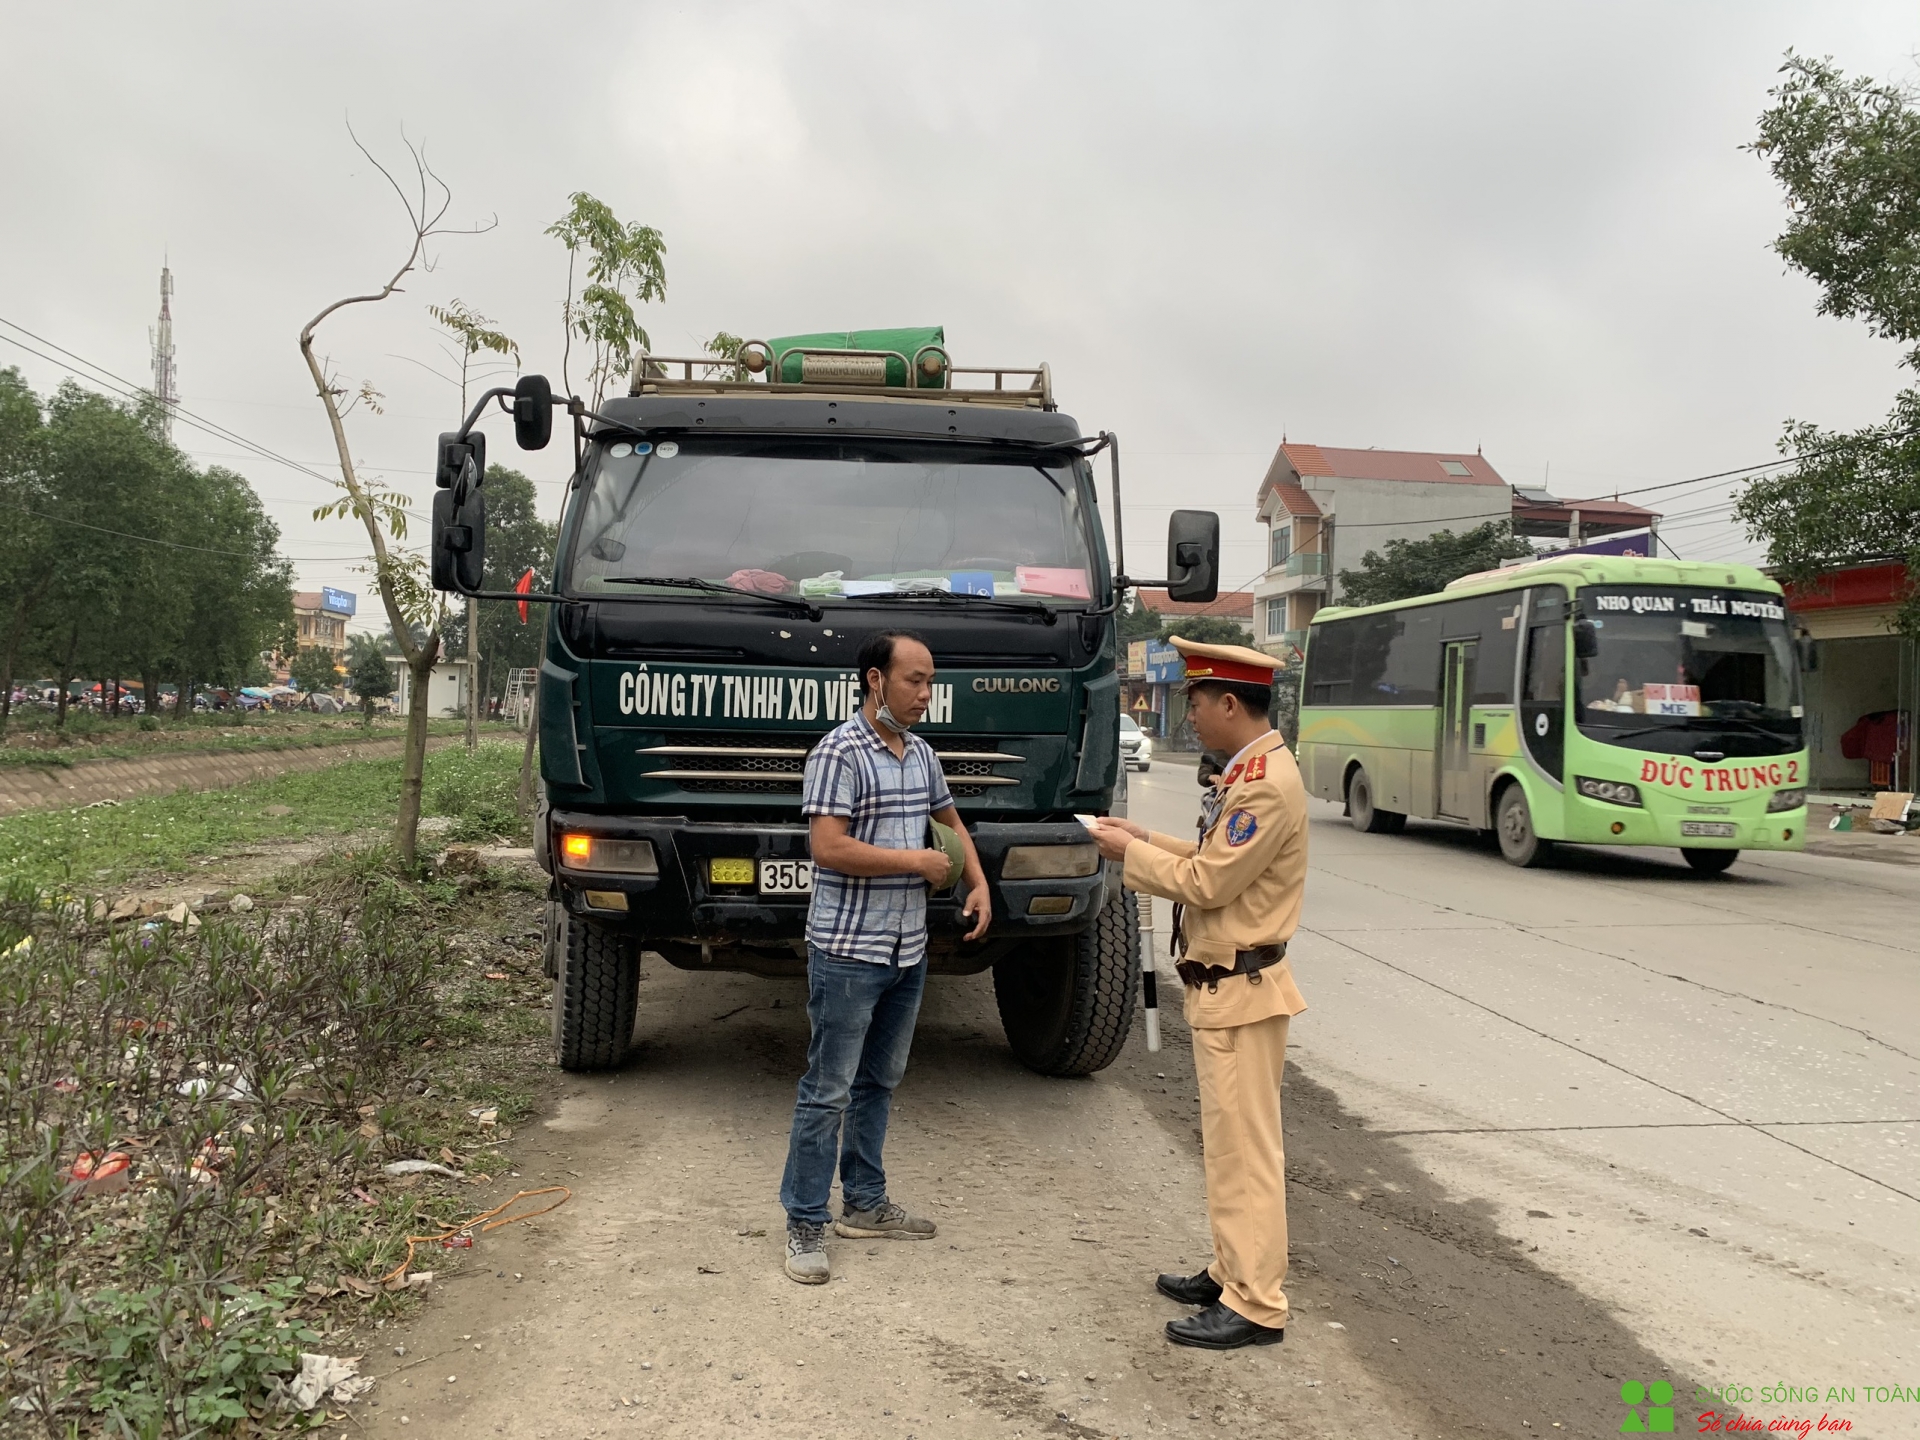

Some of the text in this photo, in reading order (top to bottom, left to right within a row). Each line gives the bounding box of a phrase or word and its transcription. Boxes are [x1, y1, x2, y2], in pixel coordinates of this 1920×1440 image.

[1596, 595, 1630, 610] NHO
[1632, 596, 1675, 614] QUAN
[1690, 595, 1728, 614] THÁI
[1730, 600, 1785, 620] NGUYÊN
[619, 663, 686, 717] CÔNG
[690, 674, 718, 717] TY
[721, 675, 784, 719] TNHH
[787, 677, 819, 721] XD
[972, 677, 1061, 693] CUULONG
[1640, 756, 1799, 792] ĐỨC TRUNG 2
